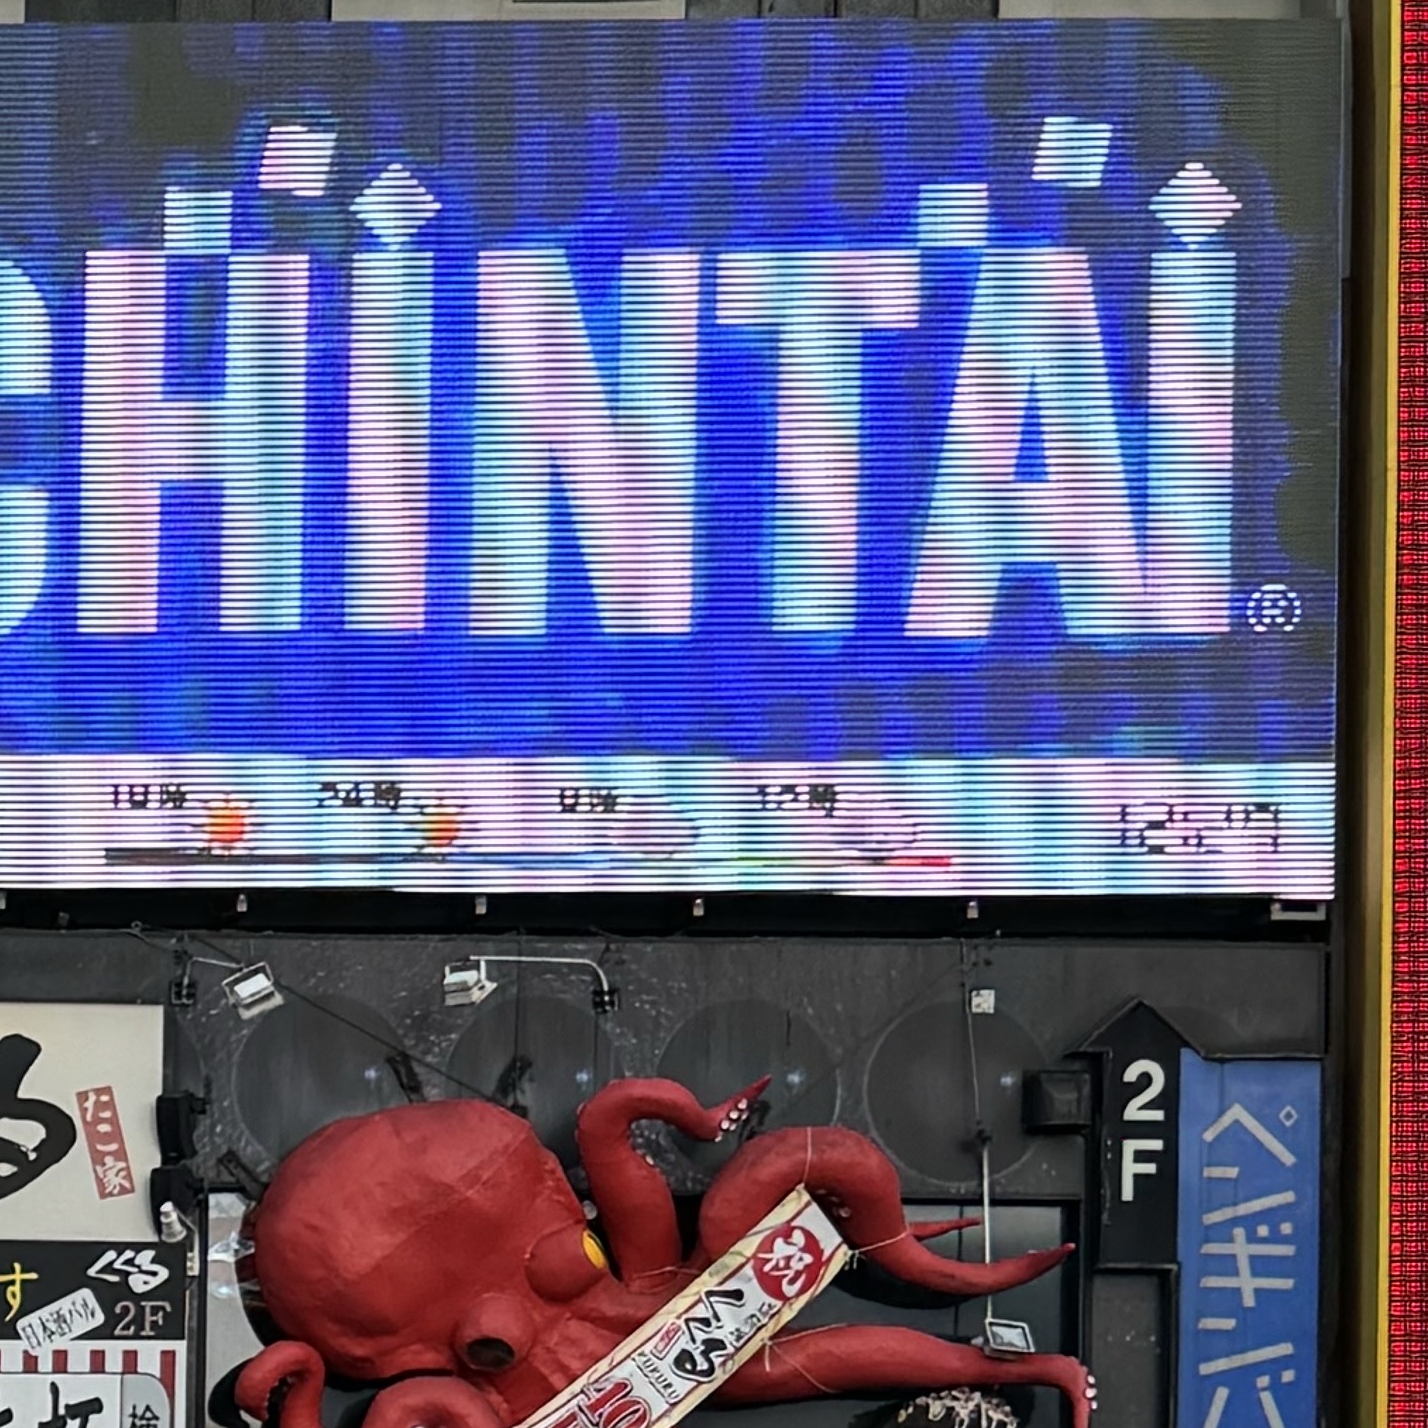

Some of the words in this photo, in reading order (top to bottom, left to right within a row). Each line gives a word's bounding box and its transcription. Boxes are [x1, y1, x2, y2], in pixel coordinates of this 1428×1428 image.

[1119, 1058, 1166, 1202] 2F
[86, 1249, 170, 1294] くくる
[112, 1300, 173, 1337] 2F
